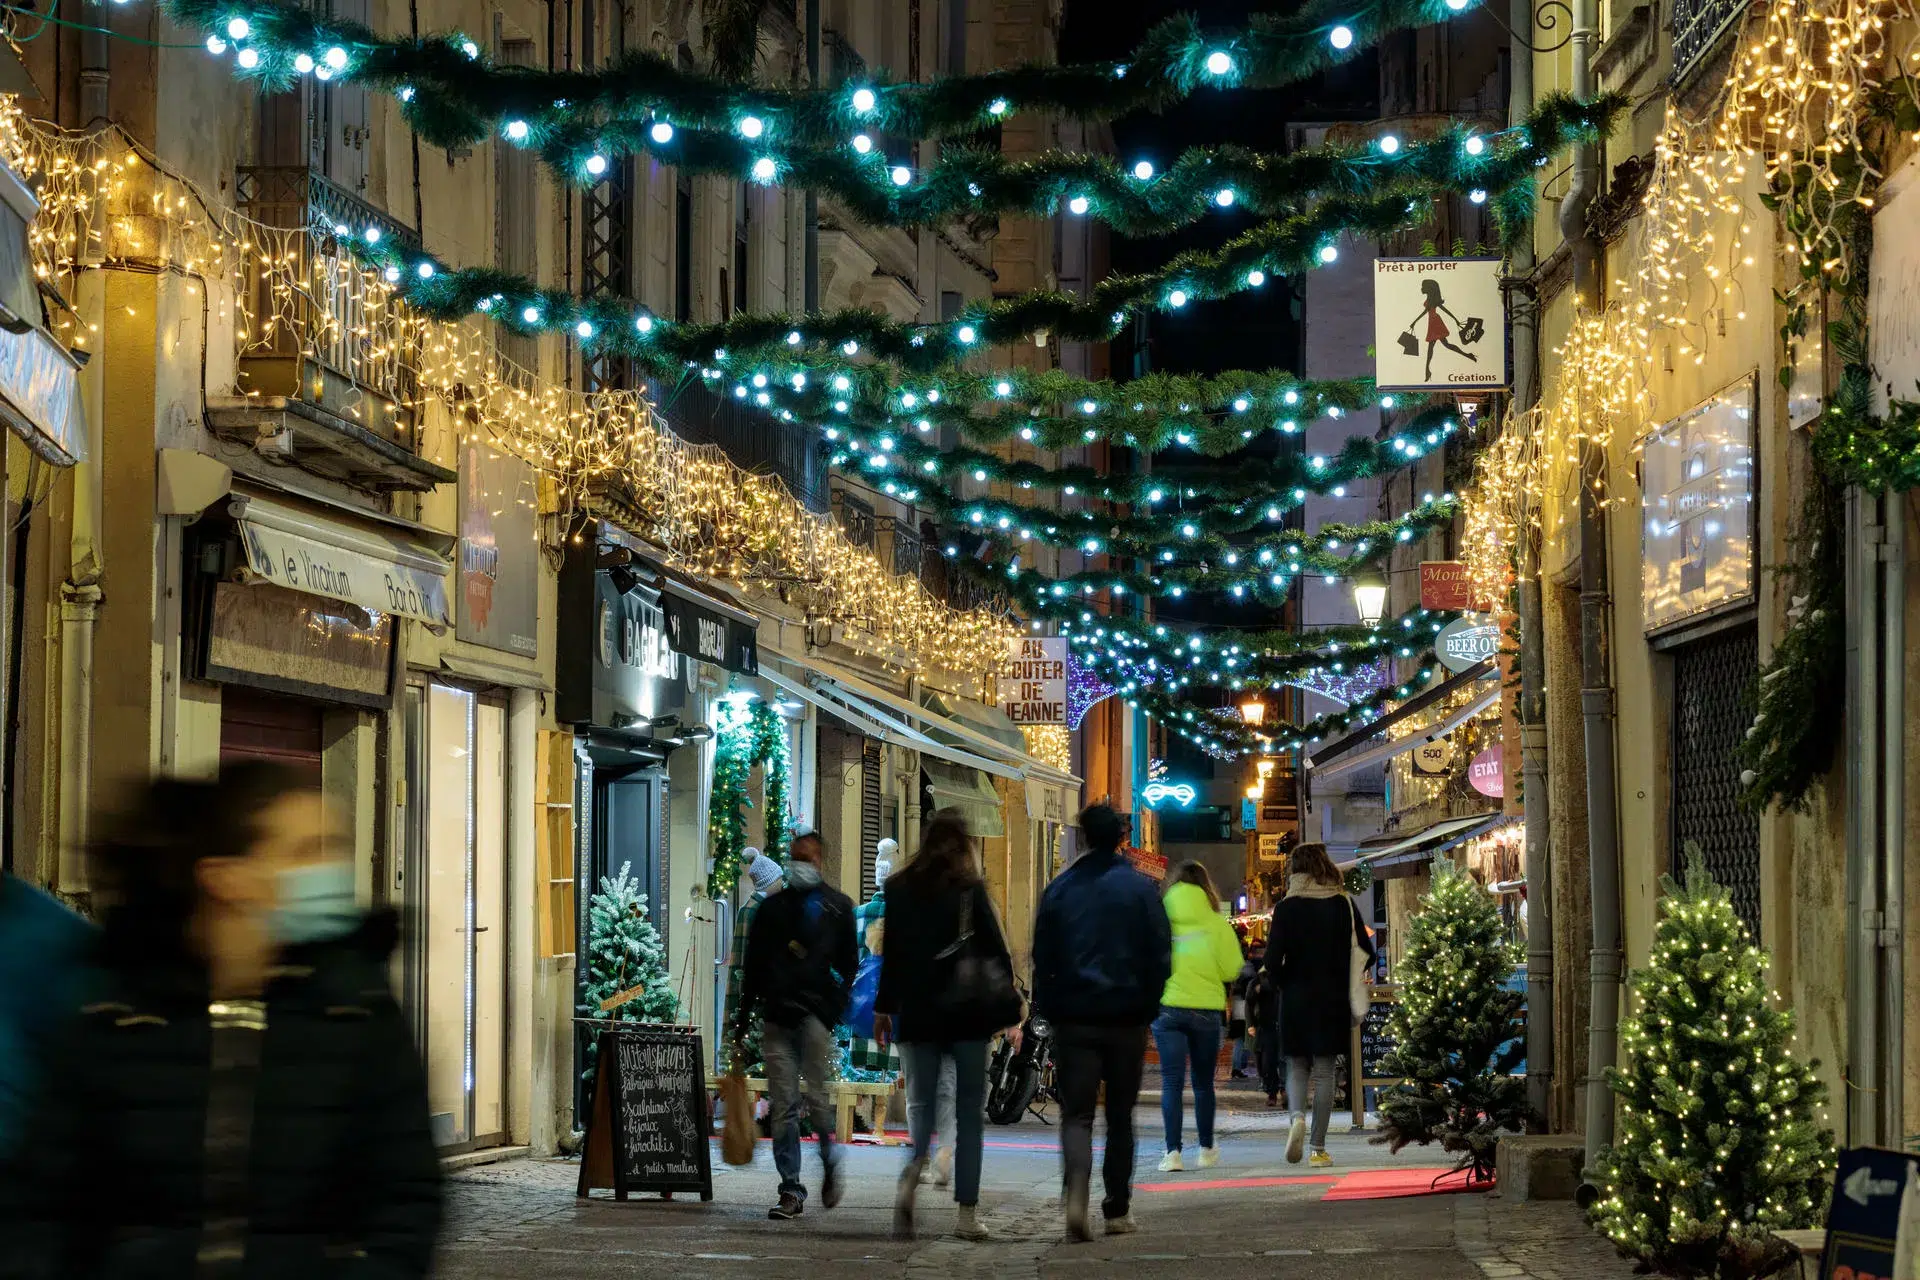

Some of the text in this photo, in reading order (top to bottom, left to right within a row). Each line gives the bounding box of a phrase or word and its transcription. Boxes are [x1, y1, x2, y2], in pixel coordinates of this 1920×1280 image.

[1378, 261, 1458, 273] Prêt à porter
[1448, 373, 1497, 382] Créations
[282, 547, 433, 619] le Vinarium Bar à vin
[1021, 639, 1042, 659] AU
[1446, 638, 1478, 653] BEER
[1021, 681, 1043, 701] DE
[1423, 748, 1442, 759] 500
[1474, 760, 1498, 777] ETAT
[628, 1118, 659, 1140] bijoux
